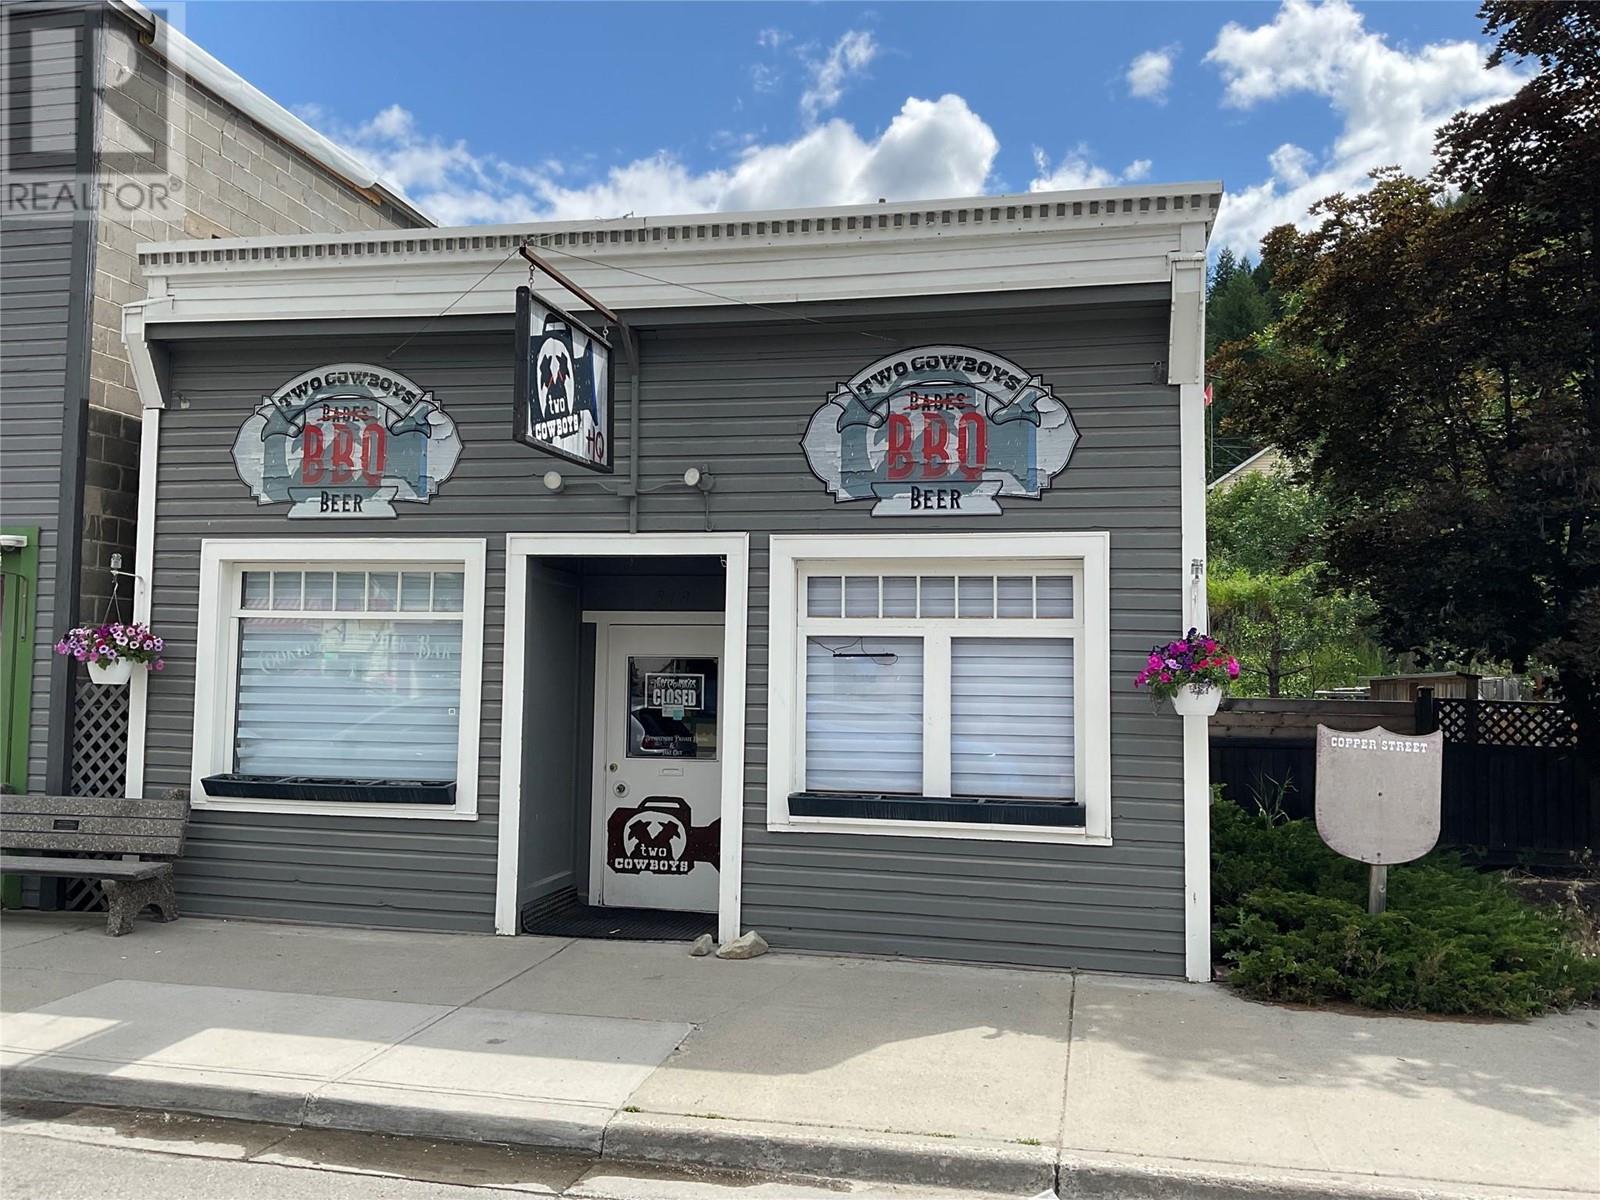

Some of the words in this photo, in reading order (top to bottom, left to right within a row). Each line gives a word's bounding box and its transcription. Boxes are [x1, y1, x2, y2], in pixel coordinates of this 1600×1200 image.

[856, 361, 907, 396] TWO
[911, 354, 1022, 391] COWBOYS
[278, 376, 322, 409] TWO
[324, 372, 417, 405] COWBOYS
[549, 395, 566, 414] two
[535, 413, 580, 440] COWBOYS
[302, 422, 388, 487] BBQ
[887, 411, 988, 481] BBQ
[320, 490, 364, 513] BEER
[910, 486, 961, 510] BEER
[653, 688, 697, 706] CLOSED
[1331, 737, 1377, 750] COPPER
[1381, 740, 1428, 753] STREET
[640, 843, 667, 857] two
[614, 857, 688, 872] COWBOYS
